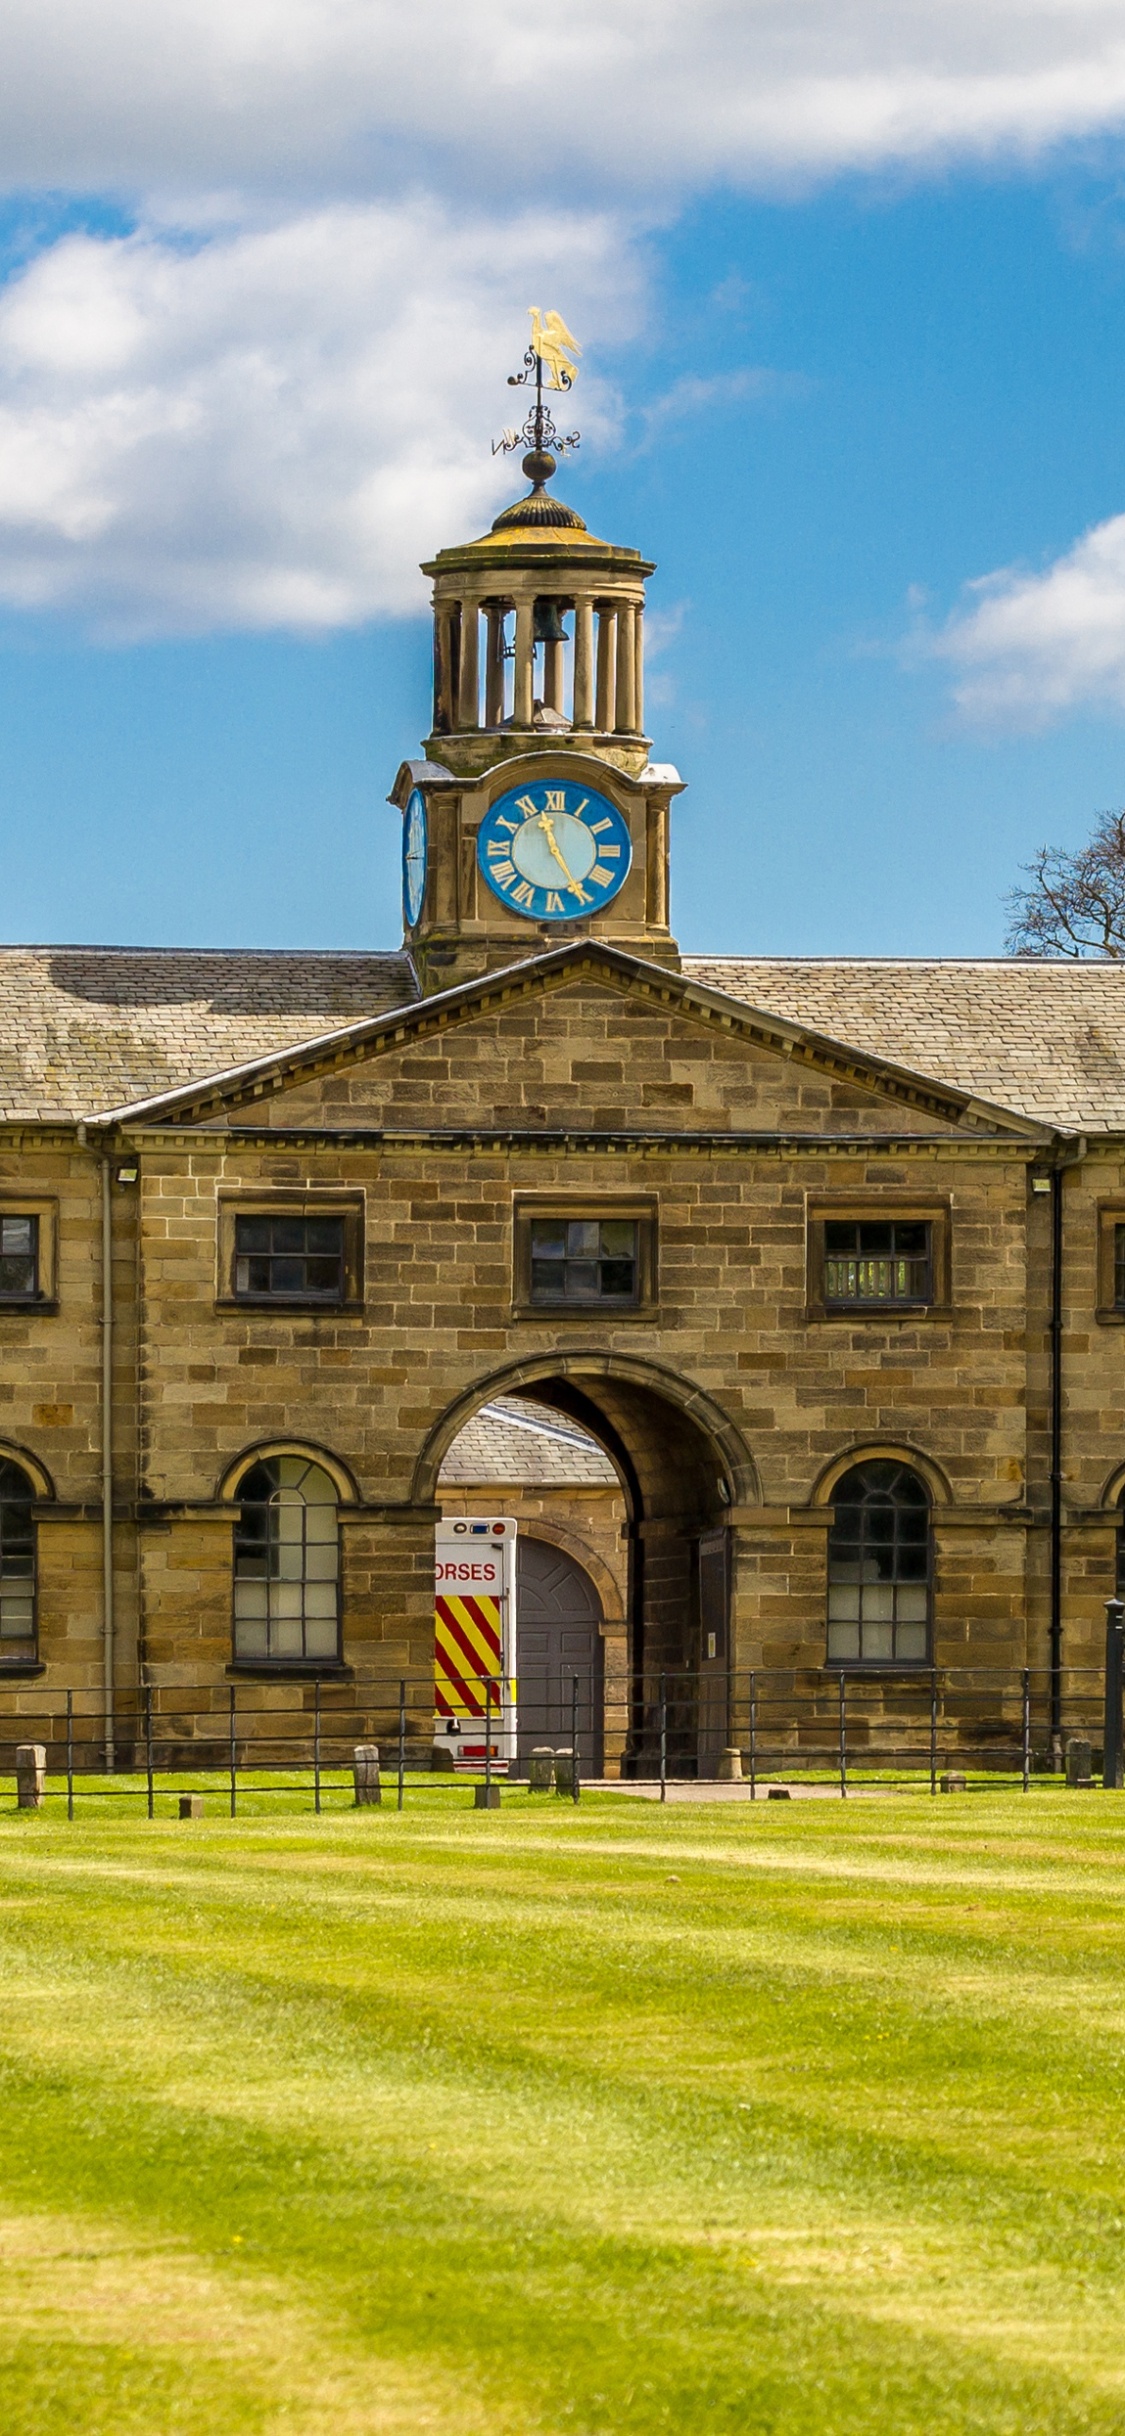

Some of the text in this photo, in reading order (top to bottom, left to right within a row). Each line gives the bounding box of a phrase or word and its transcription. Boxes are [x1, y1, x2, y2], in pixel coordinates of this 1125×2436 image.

[514, 794, 539, 819] XI
[544, 790, 566, 811] XII
[574, 798, 590, 817] I
[495, 815, 520, 834] X
[590, 817, 613, 835] II
[487, 839, 510, 857] IX
[598, 844, 621, 858] III
[489, 860, 518, 891] VIII
[588, 864, 616, 888] IIII
[510, 881, 535, 908] VII
[545, 891, 565, 912] VI
[435, 1563, 496, 1581] ORSES
